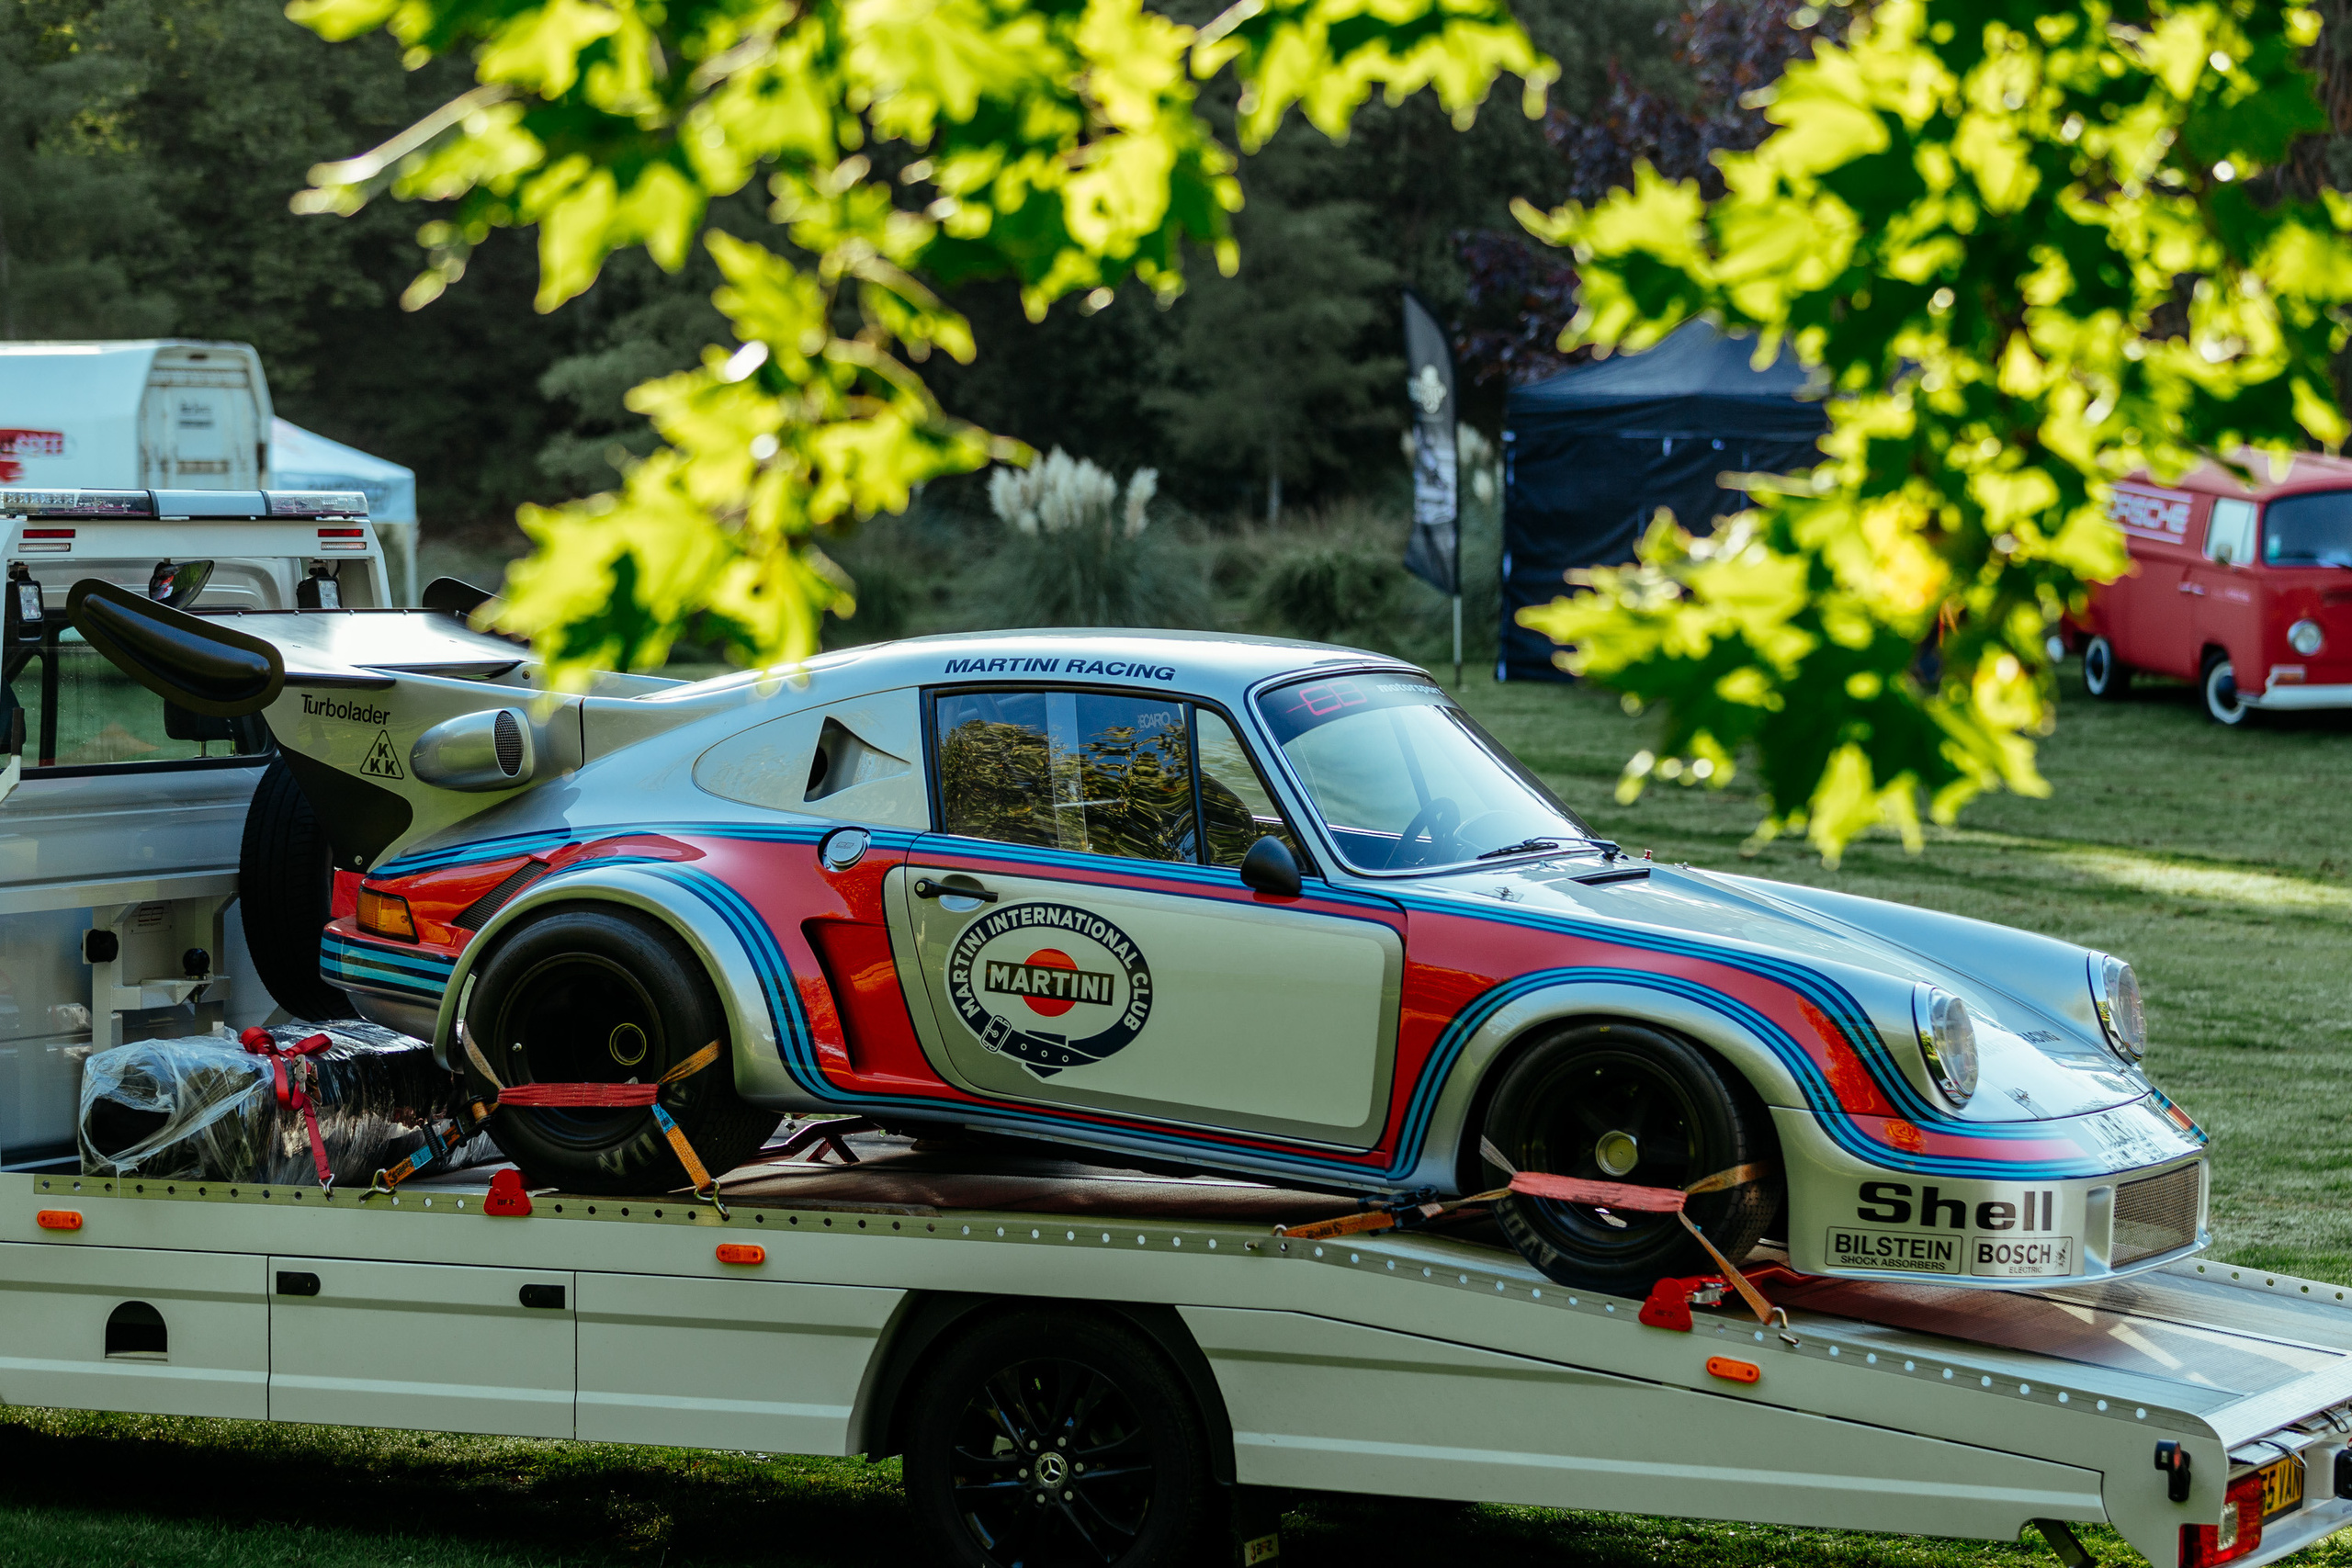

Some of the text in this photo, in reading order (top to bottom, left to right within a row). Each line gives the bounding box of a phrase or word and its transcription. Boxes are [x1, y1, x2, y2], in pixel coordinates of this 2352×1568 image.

[944, 658, 1176, 682] MARTINI RACING
[1375, 682, 1446, 696] motorsport
[300, 694, 390, 726] Turbolader
[953, 907, 1149, 1032] MARTINI INTERNATIONAL CLUB
[989, 964, 1110, 1002] MARTINI
[1857, 1180, 2052, 1232] Shell
[1834, 1233, 1953, 1262] BILSTEIN
[1977, 1242, 2052, 1265] BOSCH
[1840, 1255, 1946, 1271] SHOCK ABSORBERS
[2008, 1266, 2043, 1275] ELECTRIC
